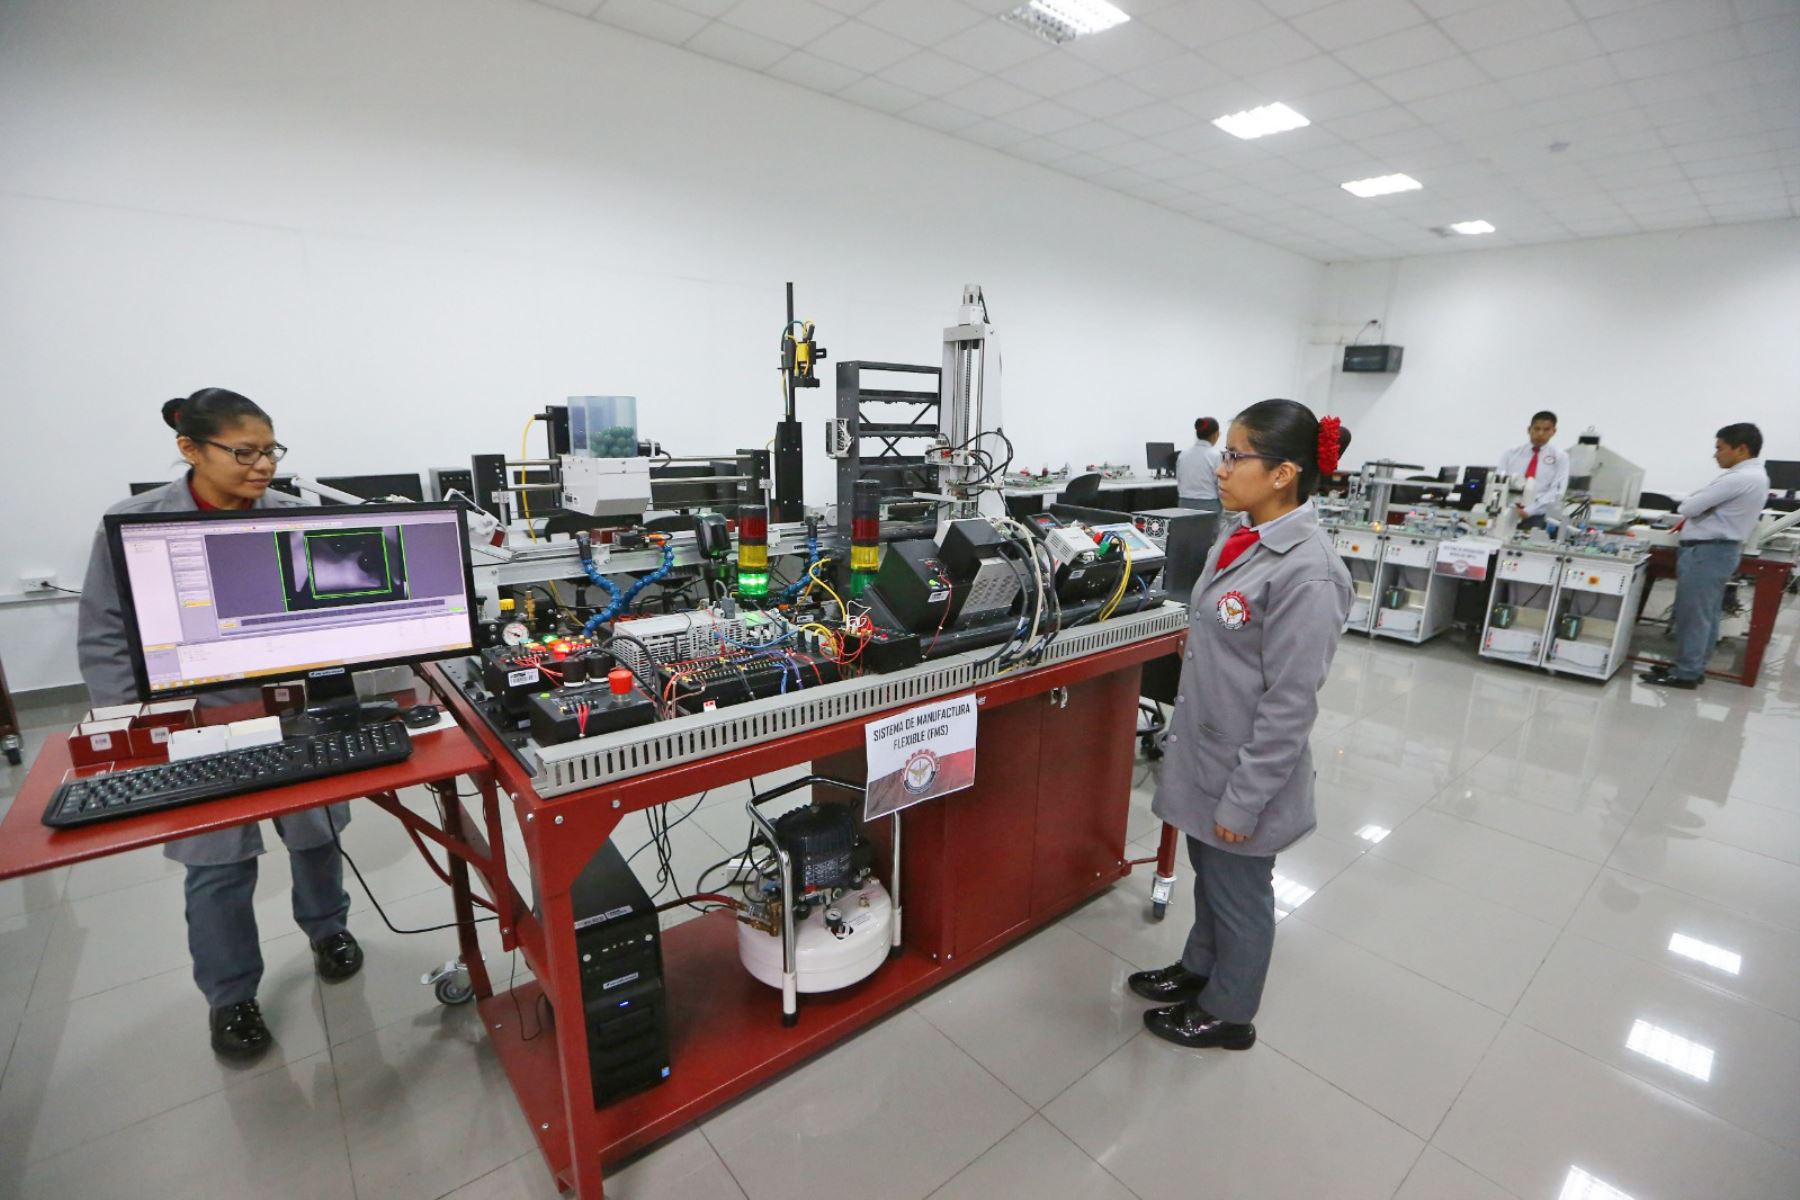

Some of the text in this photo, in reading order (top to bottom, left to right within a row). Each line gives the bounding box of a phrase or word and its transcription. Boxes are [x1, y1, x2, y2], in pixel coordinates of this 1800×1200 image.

[873, 703, 970, 741] SISTEMA DE MANUFACTURA
[893, 725, 949, 750] FLEXIBLE (FMS)
